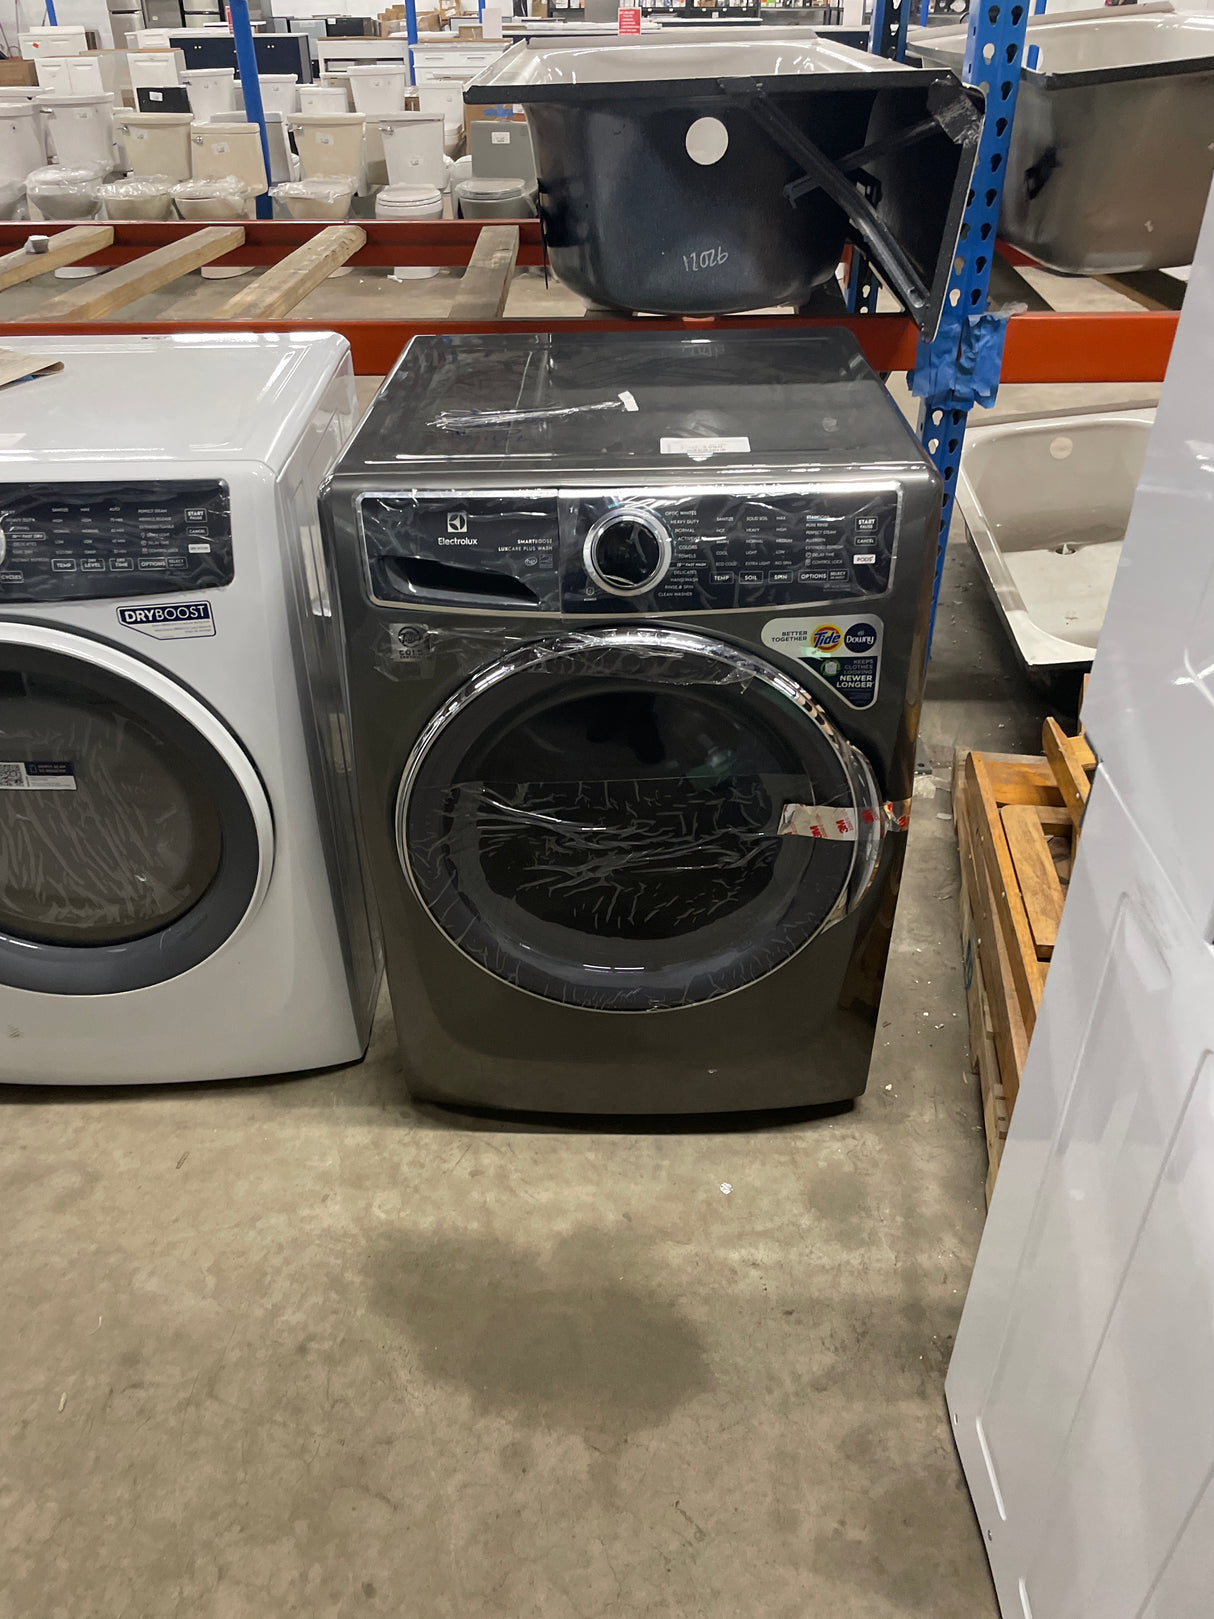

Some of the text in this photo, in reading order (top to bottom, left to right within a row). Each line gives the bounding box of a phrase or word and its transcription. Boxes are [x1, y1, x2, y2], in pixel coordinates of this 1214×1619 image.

[438, 537, 478, 546] Electrolux
[124, 605, 205, 622] DRYBOOST
[813, 630, 841, 648] Tide
[846, 635, 875, 645] Downy
